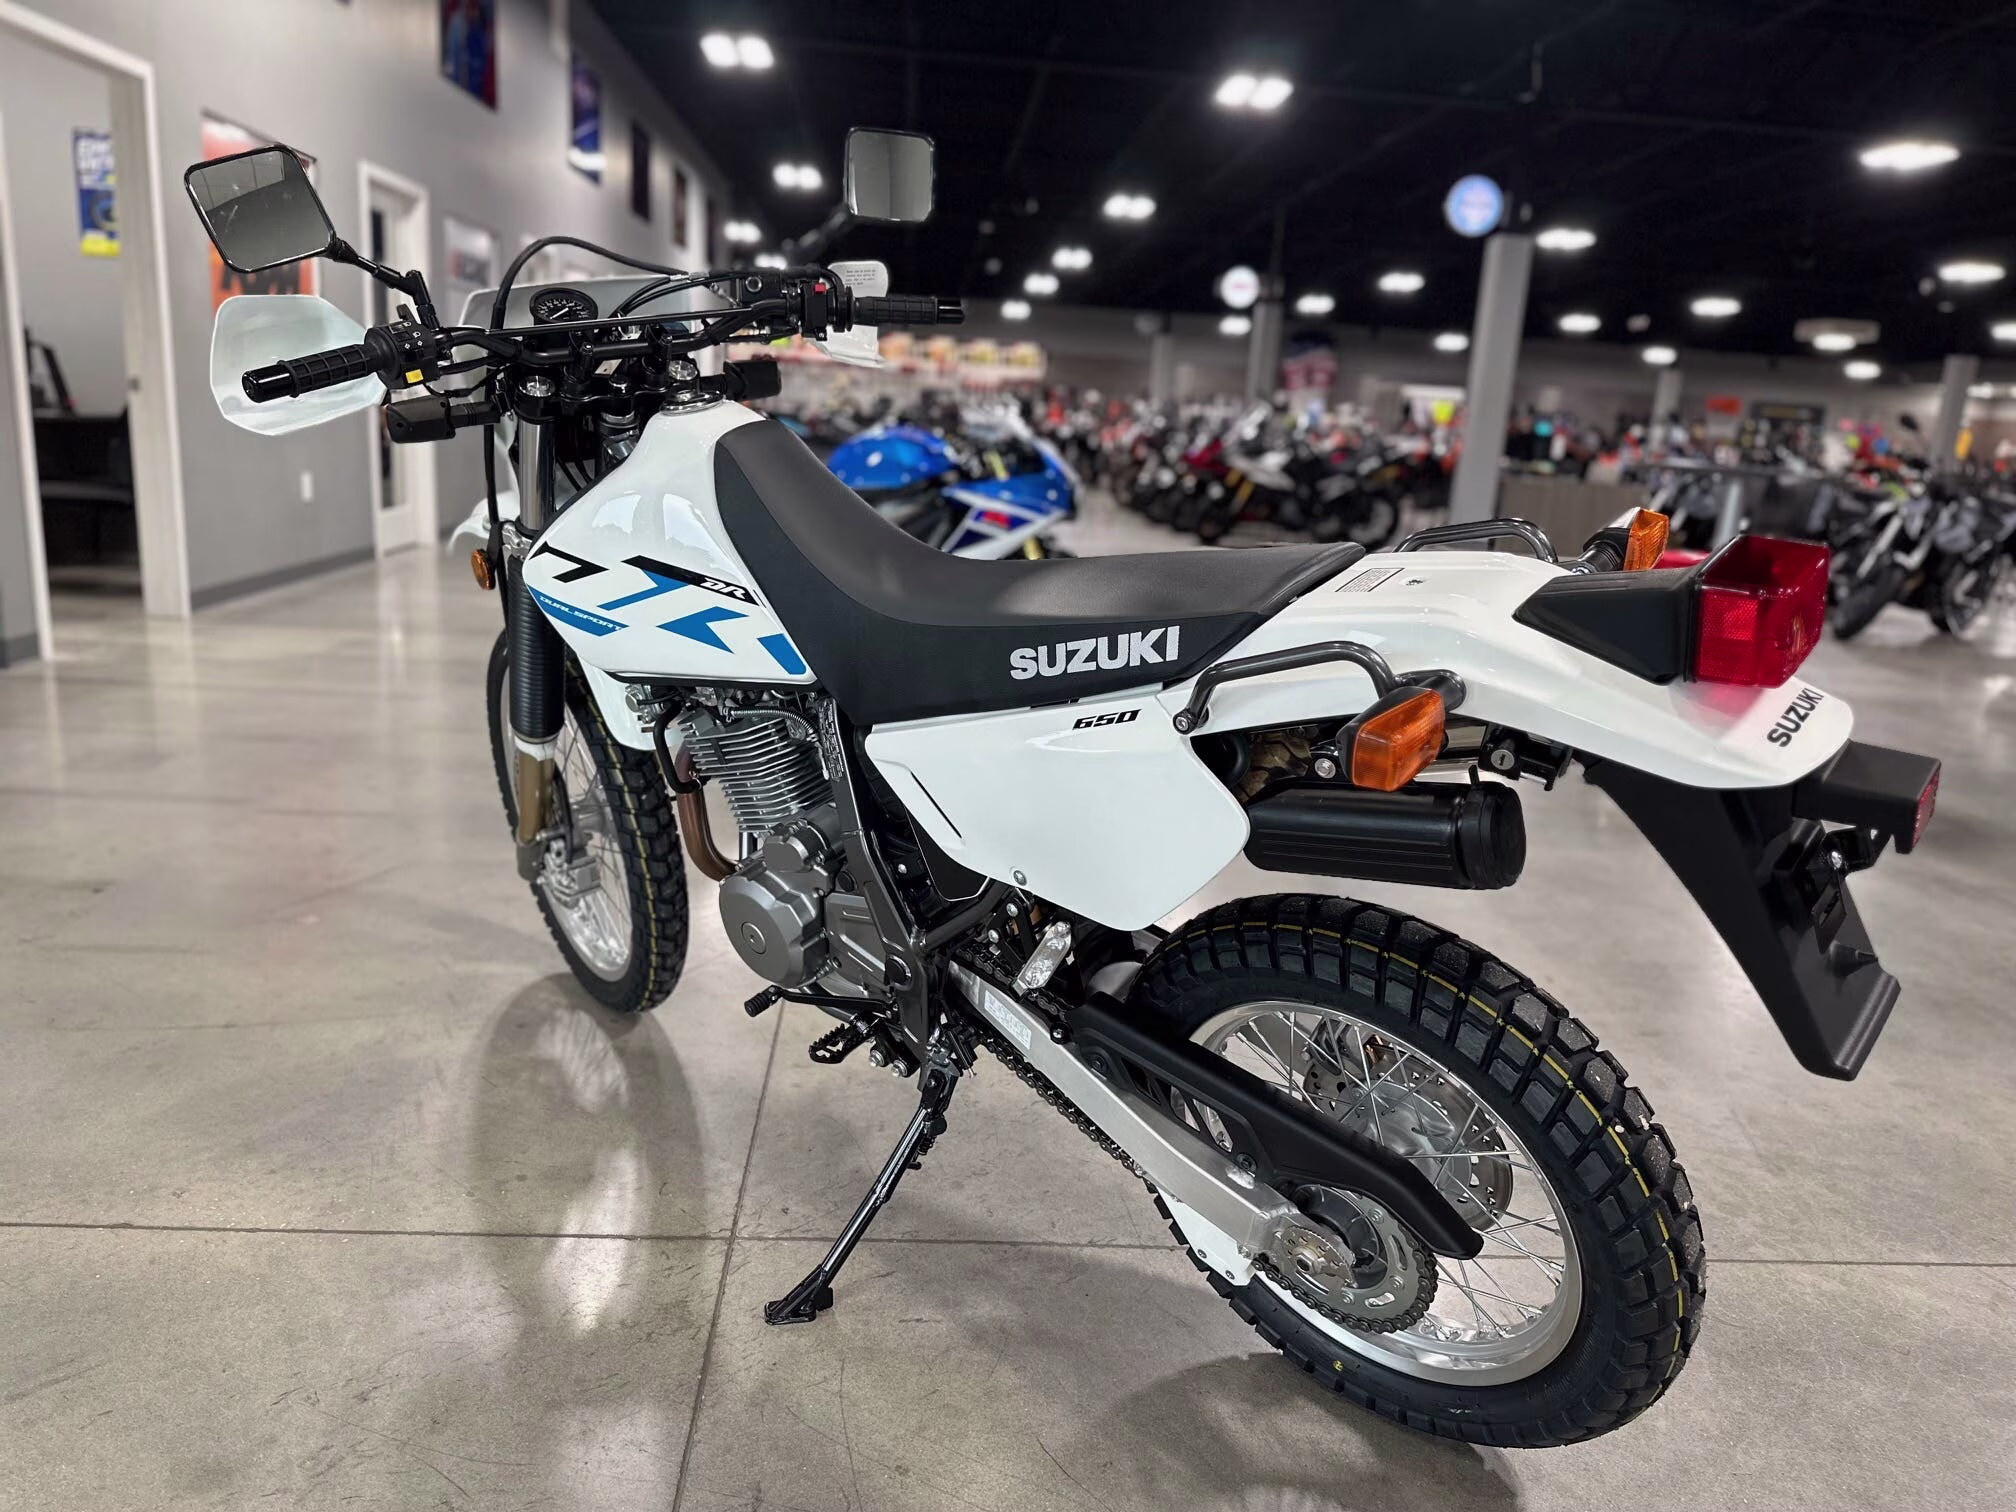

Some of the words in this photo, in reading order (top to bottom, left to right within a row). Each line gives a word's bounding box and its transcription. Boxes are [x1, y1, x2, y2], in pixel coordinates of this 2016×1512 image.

[700, 577, 746, 600] DR
[1010, 625, 1180, 680] SUZUKI
[1072, 709, 1142, 730] 650
[1766, 687, 1824, 748] SUZUKI
